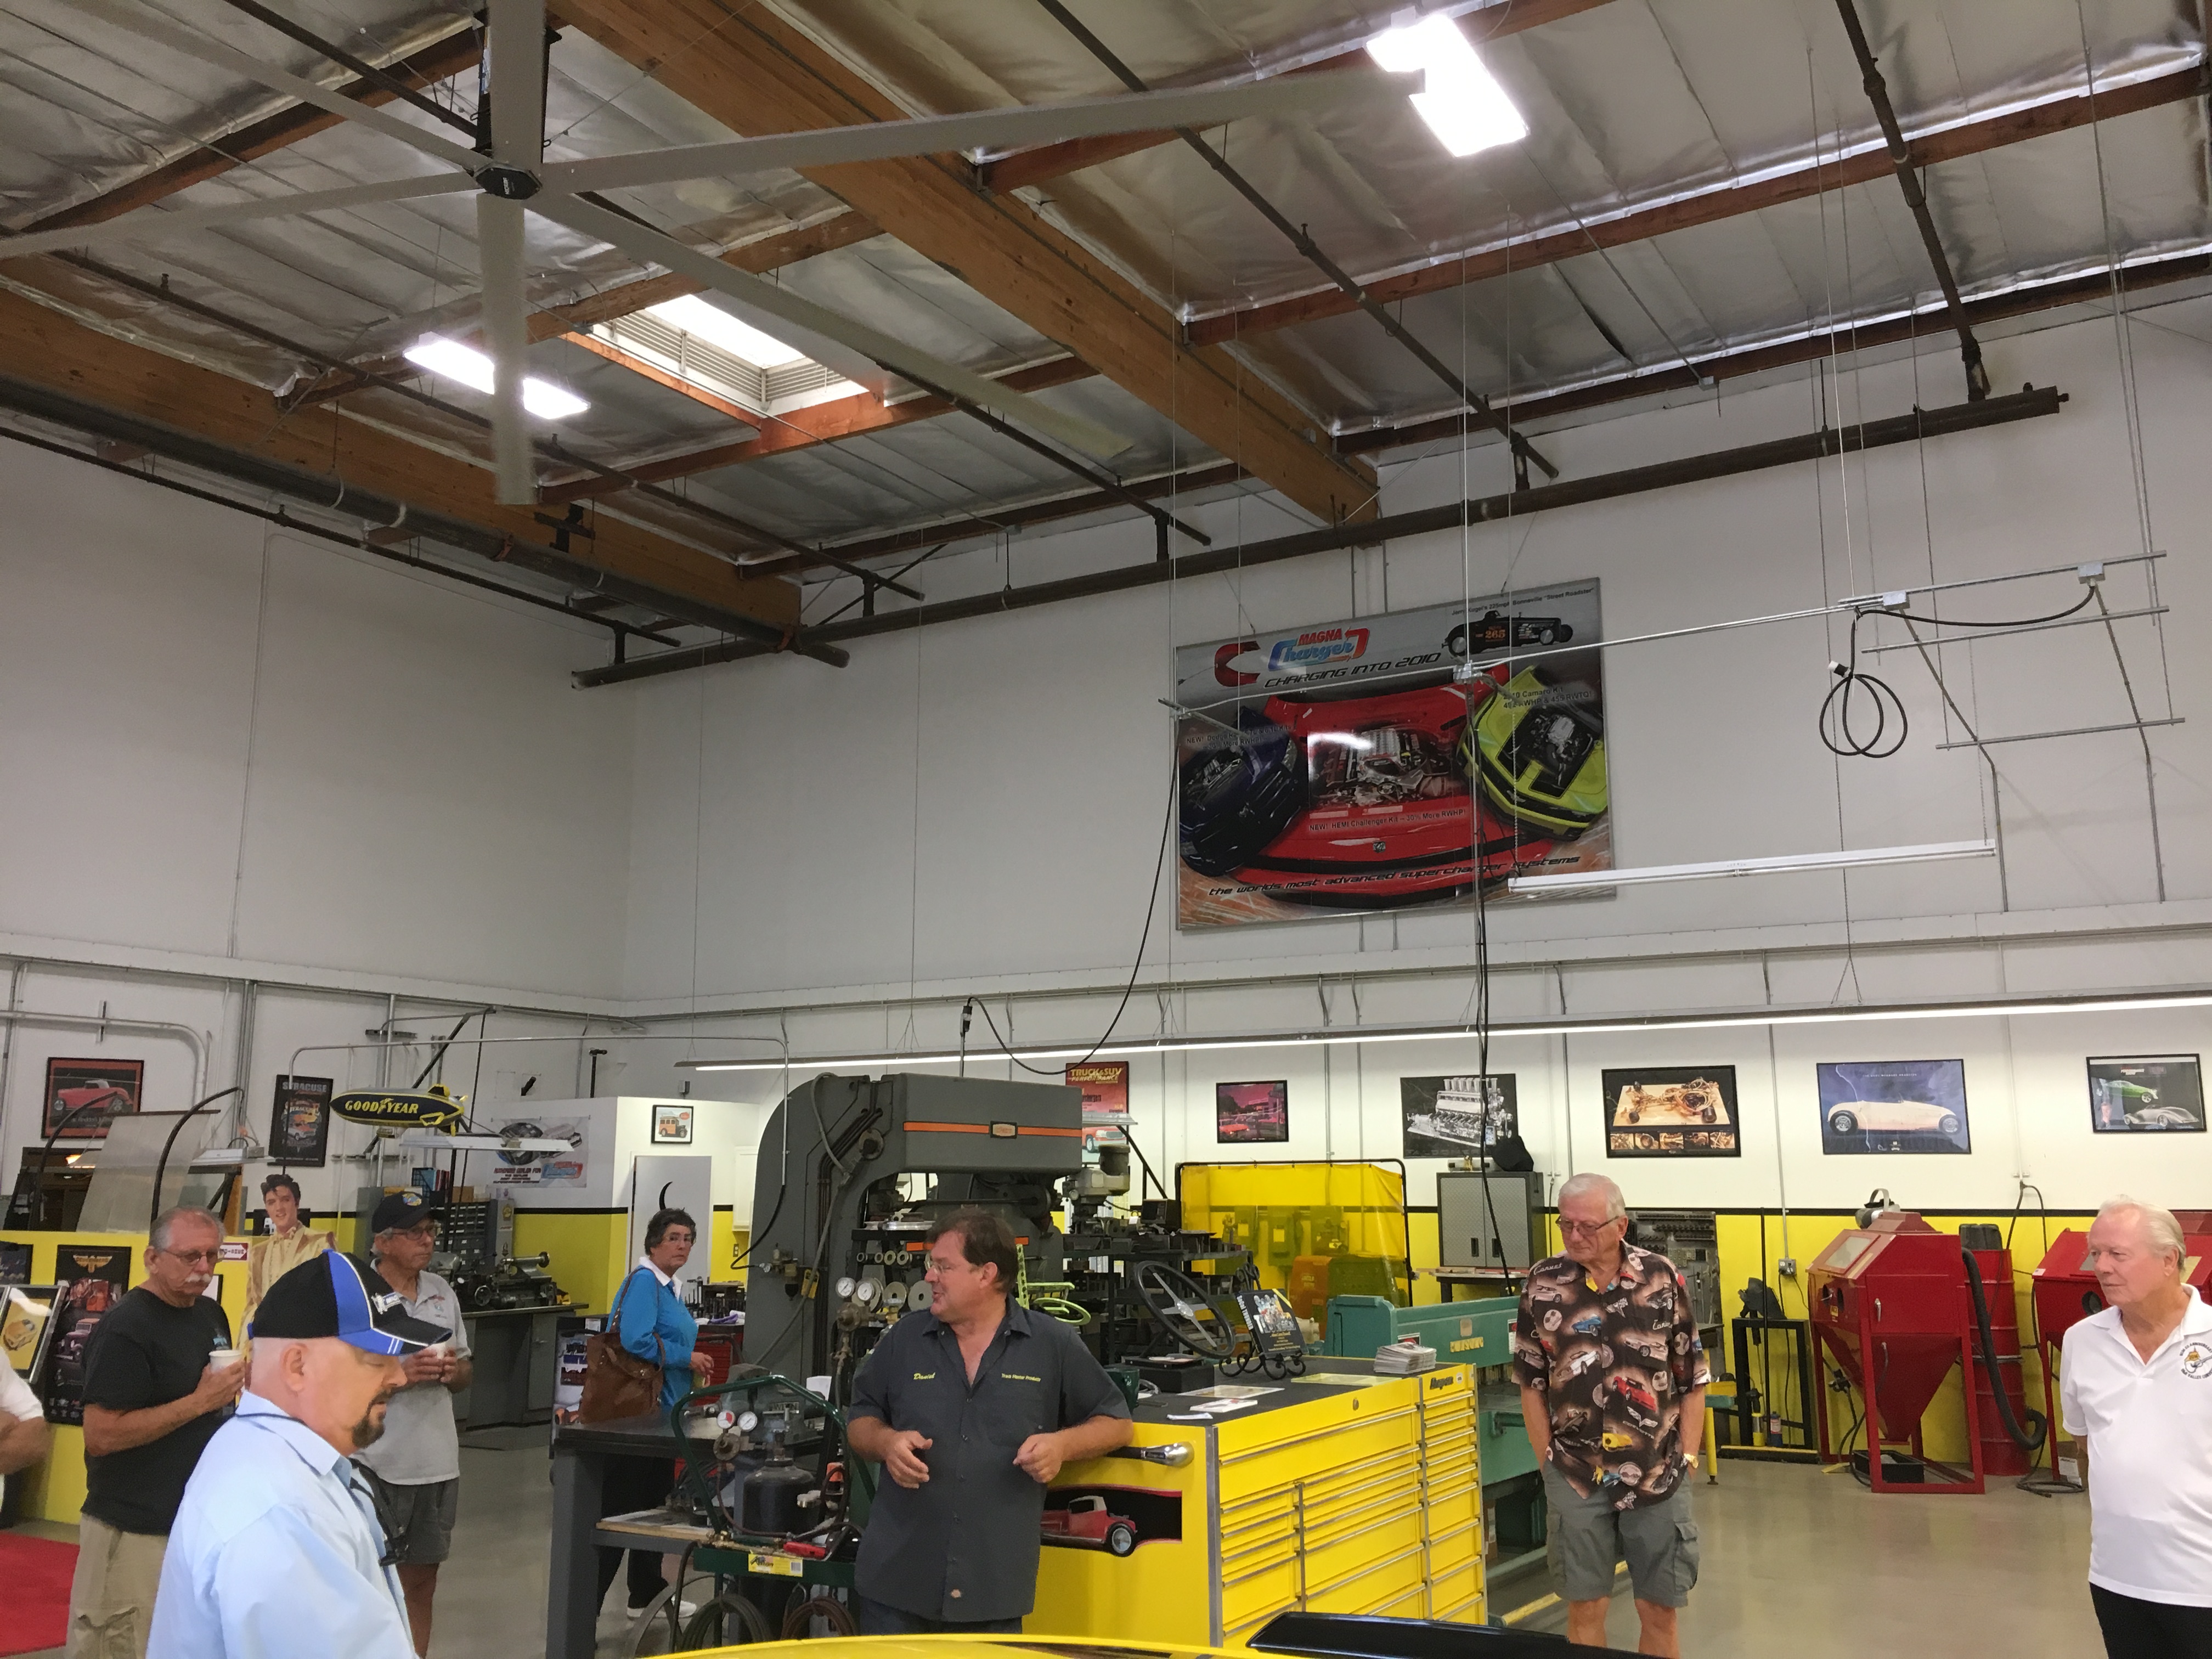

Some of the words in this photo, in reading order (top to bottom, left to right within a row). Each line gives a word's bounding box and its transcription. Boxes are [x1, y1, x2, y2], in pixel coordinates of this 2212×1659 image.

[1512, 596, 1543, 606] Bonneville
[1297, 628, 1342, 646] MAGNA
[1485, 629, 1506, 639] 265
[1264, 667, 1348, 689] CHARGING
[1351, 661, 1392, 676] INTO
[1394, 652, 1442, 668] 2010
[1522, 690, 1550, 698] Camaro
[1309, 823, 1328, 831] NEW!
[1351, 817, 1387, 827] Challenger
[1441, 809, 1465, 817] RWHP!
[1209, 887, 1233, 896] the
[1236, 882, 1282, 893] worlds
[1284, 878, 1321, 889] most
[1323, 871, 1397, 885] advanced
[1511, 856, 1581, 870] systems
[283, 1081, 328, 1093] SRACUSE
[345, 1097, 419, 1115] GOODYEAR
